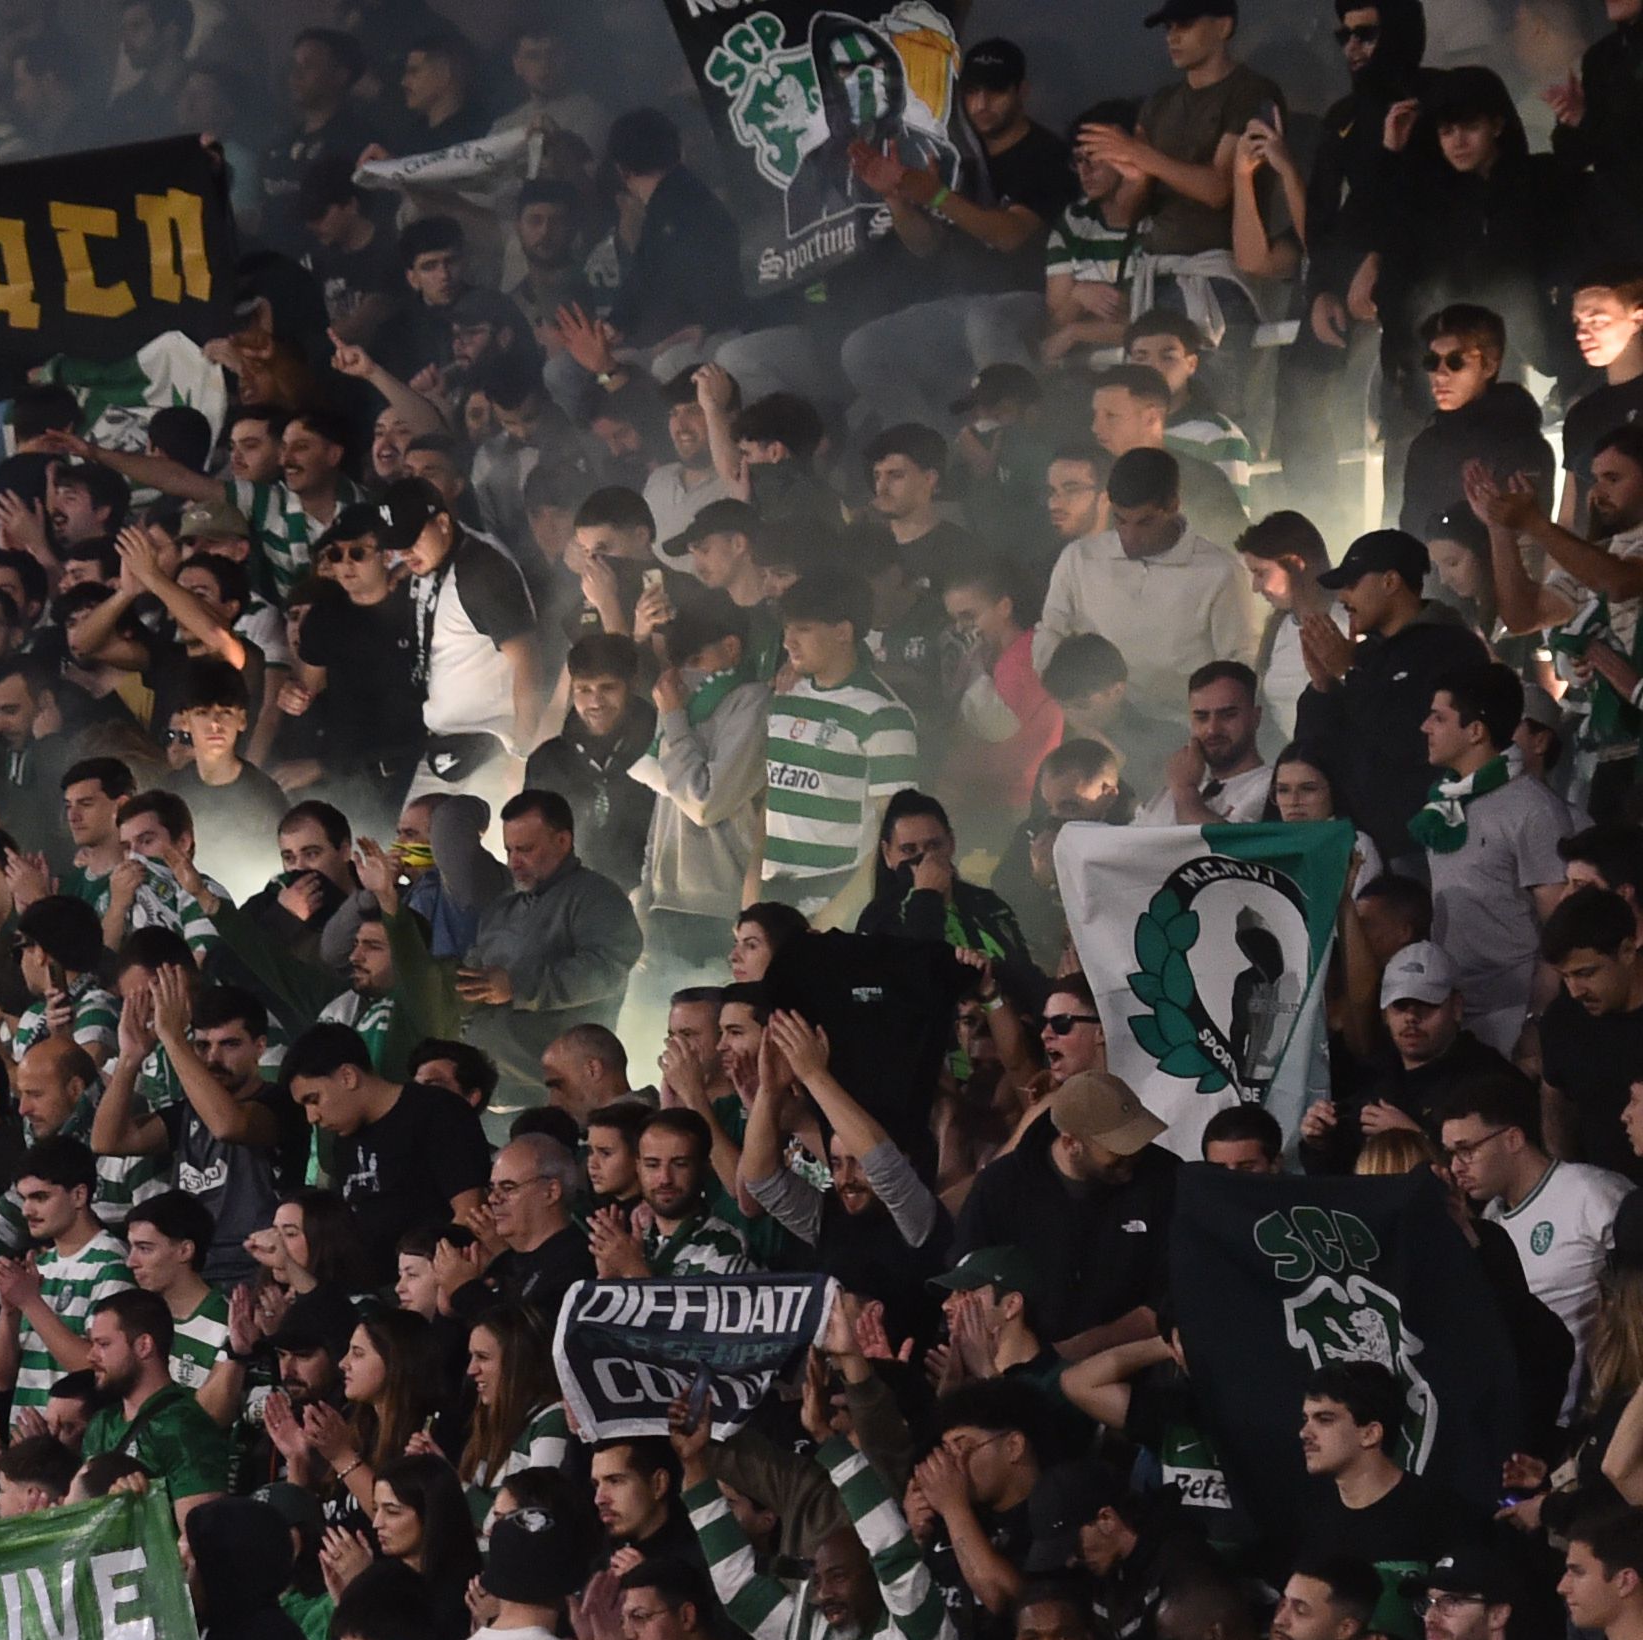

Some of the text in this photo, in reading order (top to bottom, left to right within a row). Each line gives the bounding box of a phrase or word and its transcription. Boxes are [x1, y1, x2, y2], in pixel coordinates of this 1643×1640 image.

[704, 11, 785, 97] SCP
[758, 220, 858, 283] Sporting
[768, 762, 820, 790] etano
[1252, 1205, 1381, 1282] SCP
[576, 1284, 813, 1334] DIFFIDATI
